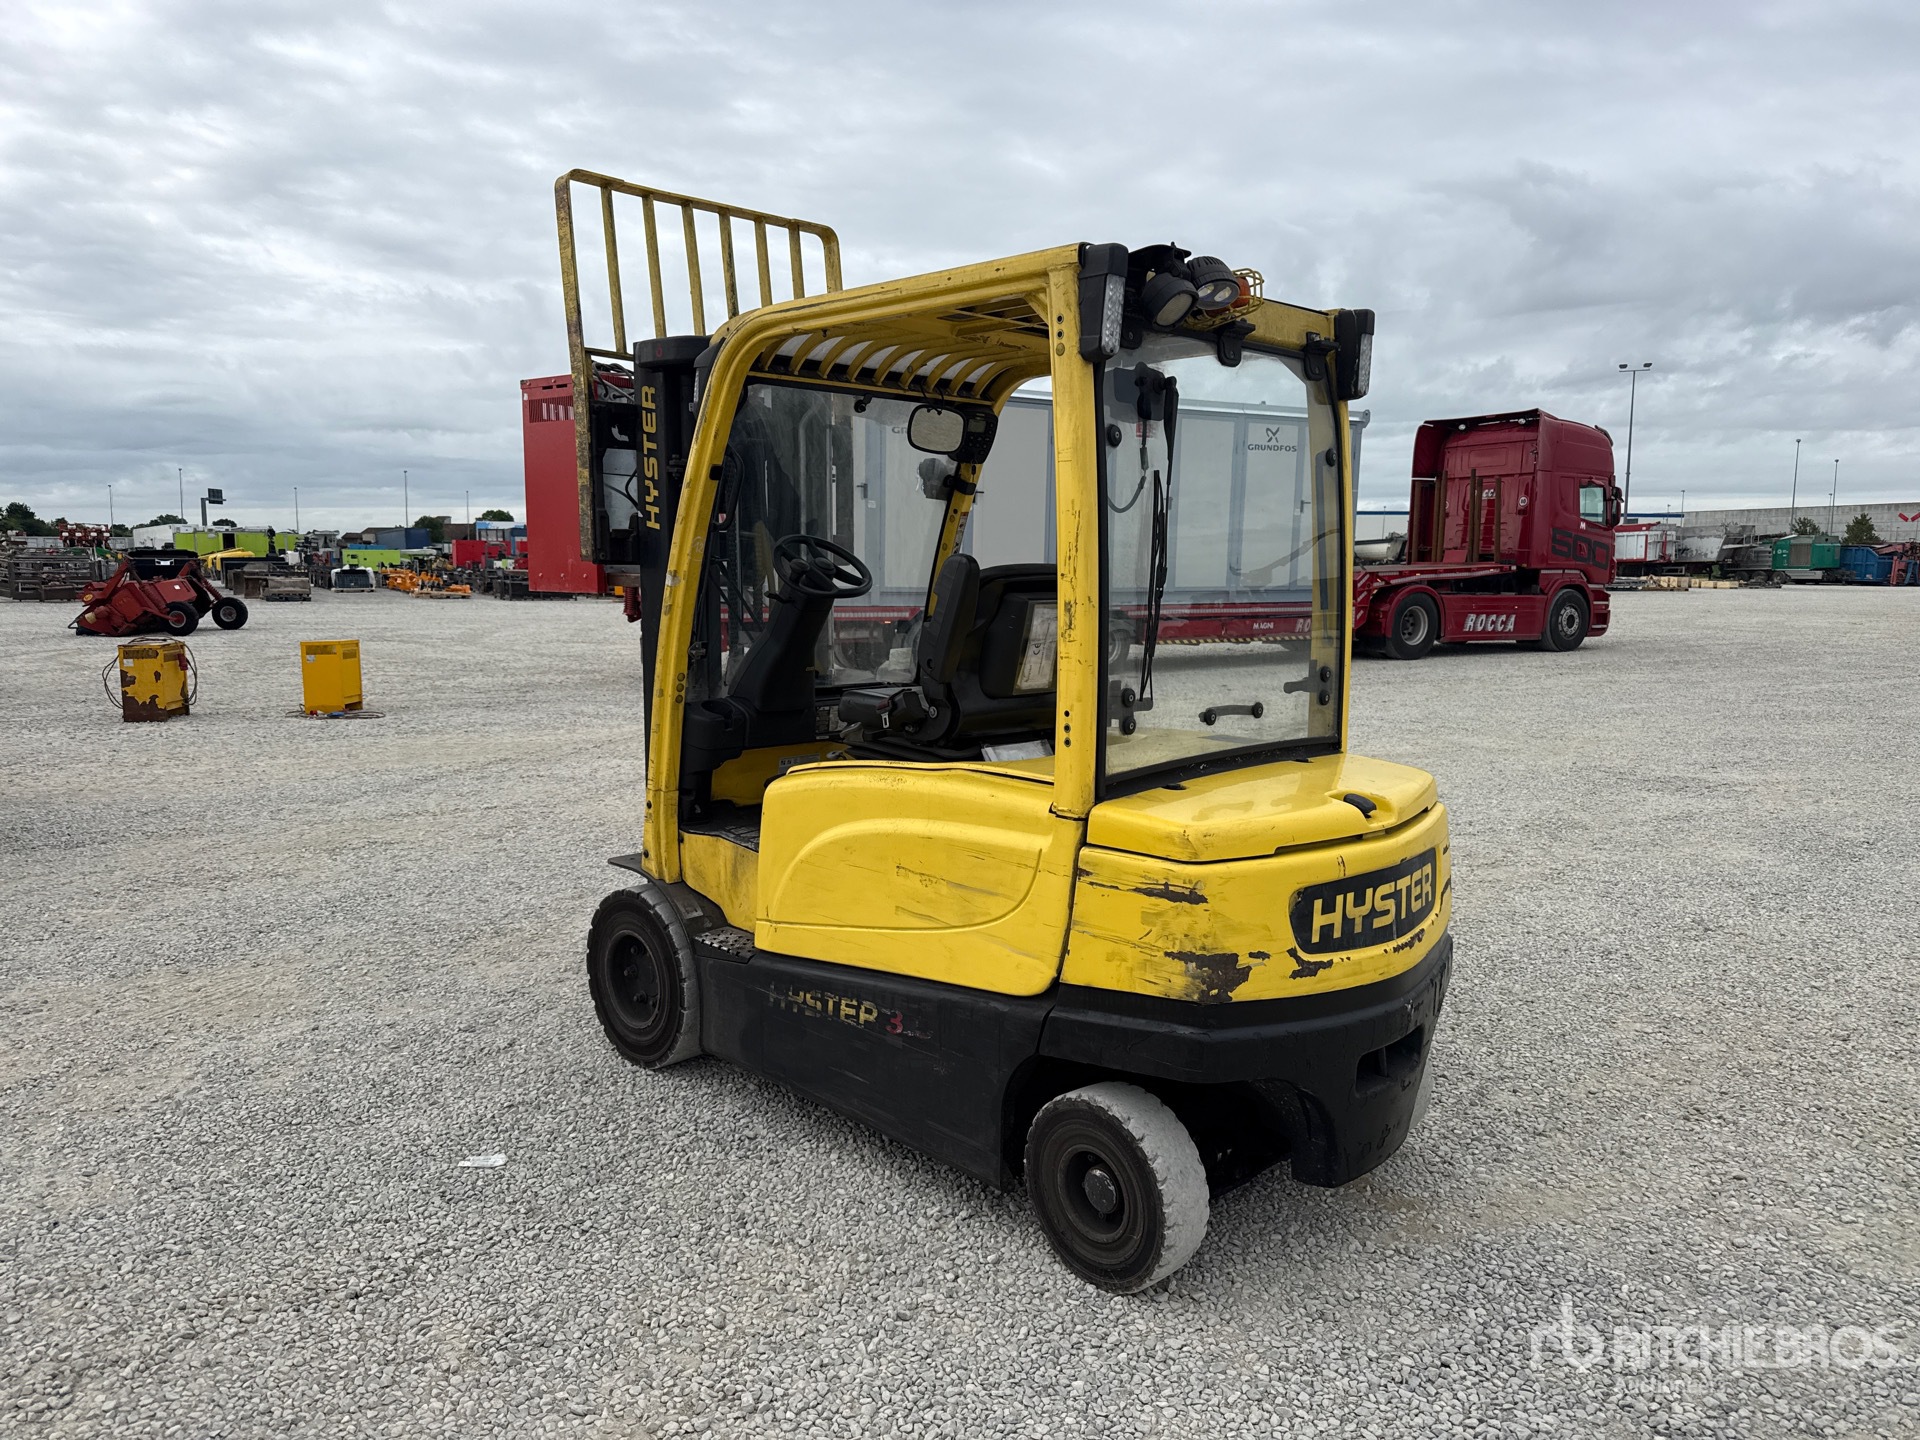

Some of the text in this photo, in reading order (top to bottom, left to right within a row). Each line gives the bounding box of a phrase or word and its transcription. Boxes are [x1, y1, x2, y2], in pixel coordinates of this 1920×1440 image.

[641, 385, 661, 530] HYSTER
[1247, 443, 1298, 453] GRUNDFOS
[1551, 527, 1610, 571] 500
[1252, 621, 1275, 631] MAGNI
[1463, 613, 1516, 632] ROCCA
[1311, 862, 1432, 944] HYSTER
